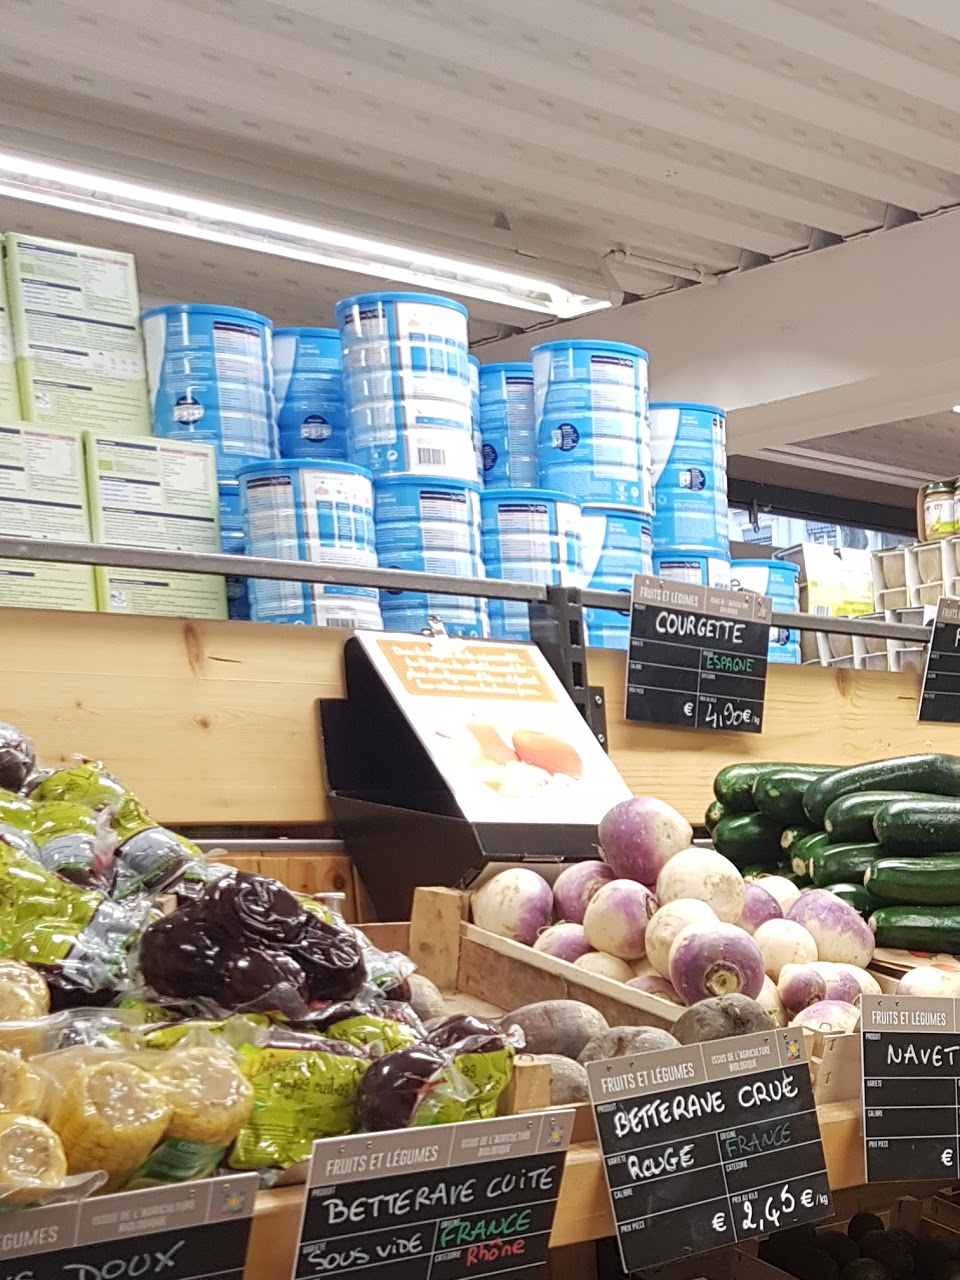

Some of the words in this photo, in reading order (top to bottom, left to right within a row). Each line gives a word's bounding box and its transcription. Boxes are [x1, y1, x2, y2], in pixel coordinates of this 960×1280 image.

[655, 612, 745, 643] COURGETTE
[707, 655, 755, 672] ESPAGNE
[706, 703, 742, 728] 4,90
[872, 1011, 898, 1025] FRUITS
[911, 1011, 946, 1026] LÉGUMES
[887, 1044, 959, 1066] NAVET
[601, 1077, 635, 1093] FRUITS
[638, 1075, 650, 1087] ET
[651, 1063, 695, 1084] LÉGUMES
[614, 1091, 726, 1137] BETTERAVE
[738, 1074, 798, 1107] CRUE
[725, 1122, 791, 1157] FRANCE
[326, 1157, 367, 1176] FRUITS
[370, 1152, 384, 1167] ET
[628, 1145, 695, 1180] ROUGE
[322, 1179, 476, 1224] BETTERAVE
[742, 1185, 795, 1231] 2,45
[440, 1210, 531, 1247] FRANCE
[712, 1212, 727, 1232] €
[307, 1250, 370, 1270] SOUS
[466, 1238, 525, 1266] Rhône
